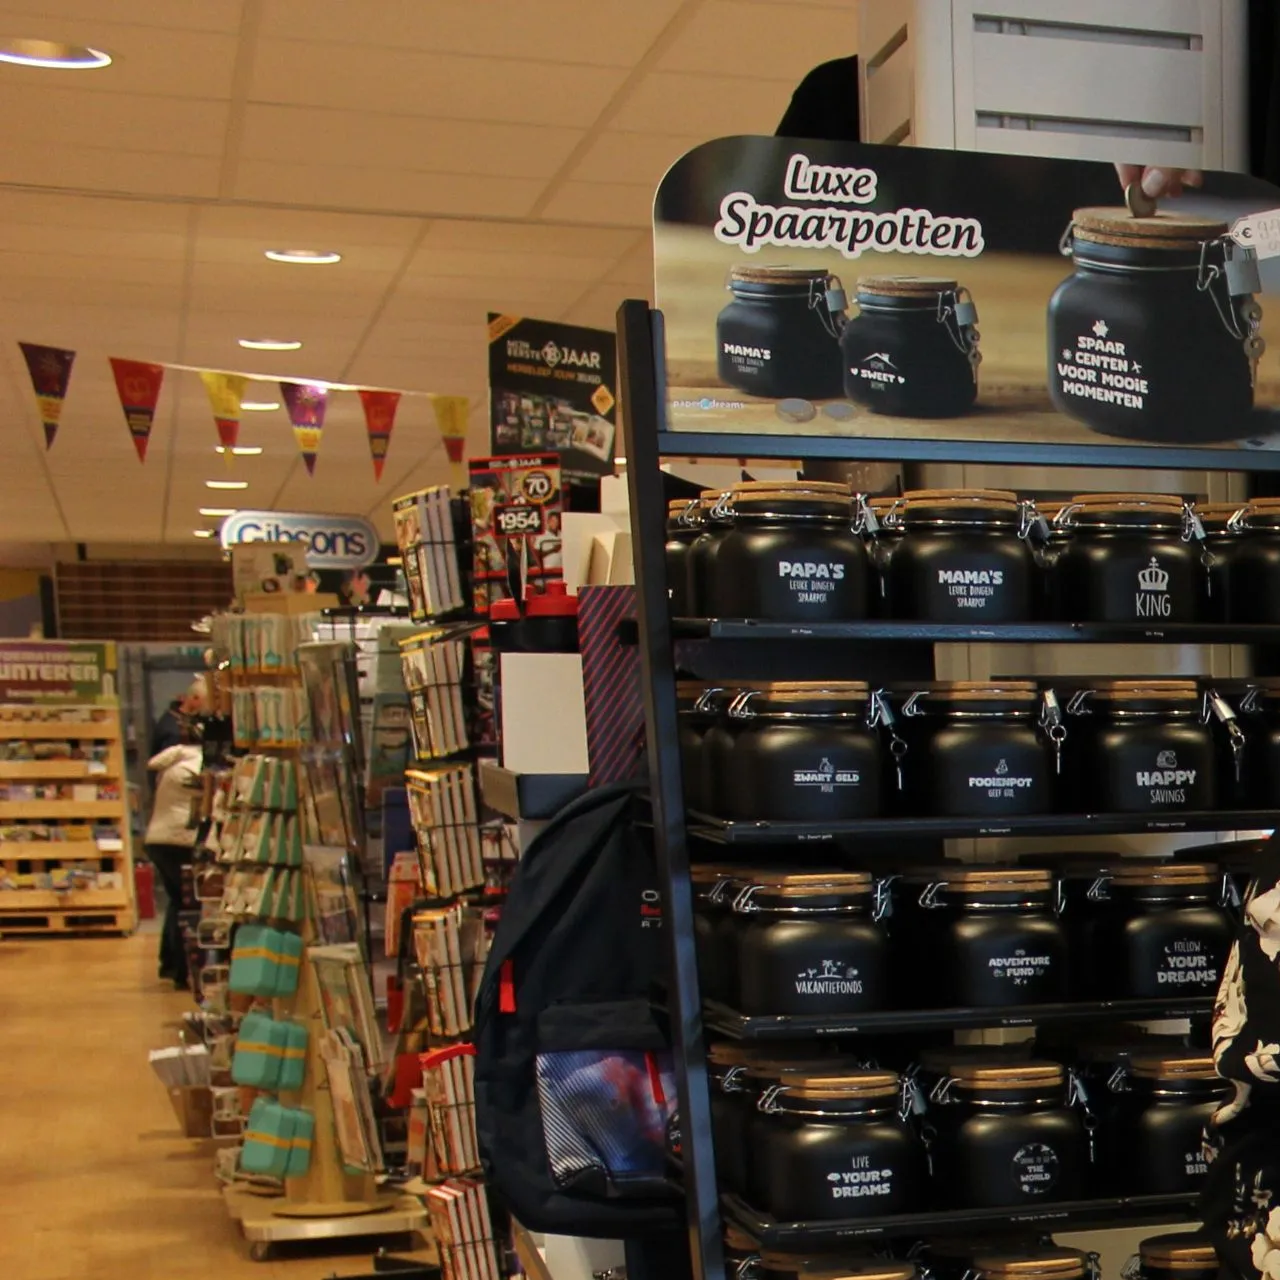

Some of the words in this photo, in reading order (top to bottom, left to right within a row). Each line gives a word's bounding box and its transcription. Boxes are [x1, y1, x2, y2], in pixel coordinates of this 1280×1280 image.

[791, 157, 874, 198] Luxe
[721, 200, 981, 250] Spaarpotten
[724, 343, 771, 360] MAMA'S
[1077, 335, 1126, 356] SPAAR
[561, 347, 601, 368] JAAR
[1075, 351, 1129, 373] CENTEN
[860, 369, 896, 384] SWEET
[1057, 363, 1097, 382] VOOR
[1063, 380, 1143, 409] MOMENTEN
[526, 476, 549, 495] 70
[497, 512, 540, 530] 1954
[779, 561, 845, 580] PAPA'S
[938, 570, 1003, 585] MAMA'S
[1135, 592, 1172, 617] KING
[794, 773, 831, 782] ZWART
[835, 773, 860, 783] GELD
[1136, 770, 1197, 787] HAPPY
[1150, 788, 1185, 804] SAVINGS
[1174, 941, 1200, 953] FOLLOW
[988, 956, 1050, 967] ADVENTURE
[1167, 954, 1207, 969] YOUR
[1006, 967, 1035, 977] FUND
[1156, 968, 1217, 984] DREAMS
[795, 980, 863, 995] VAKANTIEFONDS
[852, 1155, 870, 1170] LIVE
[841, 1168, 881, 1184] YOUR
[832, 1182, 891, 1198] DREAMS
